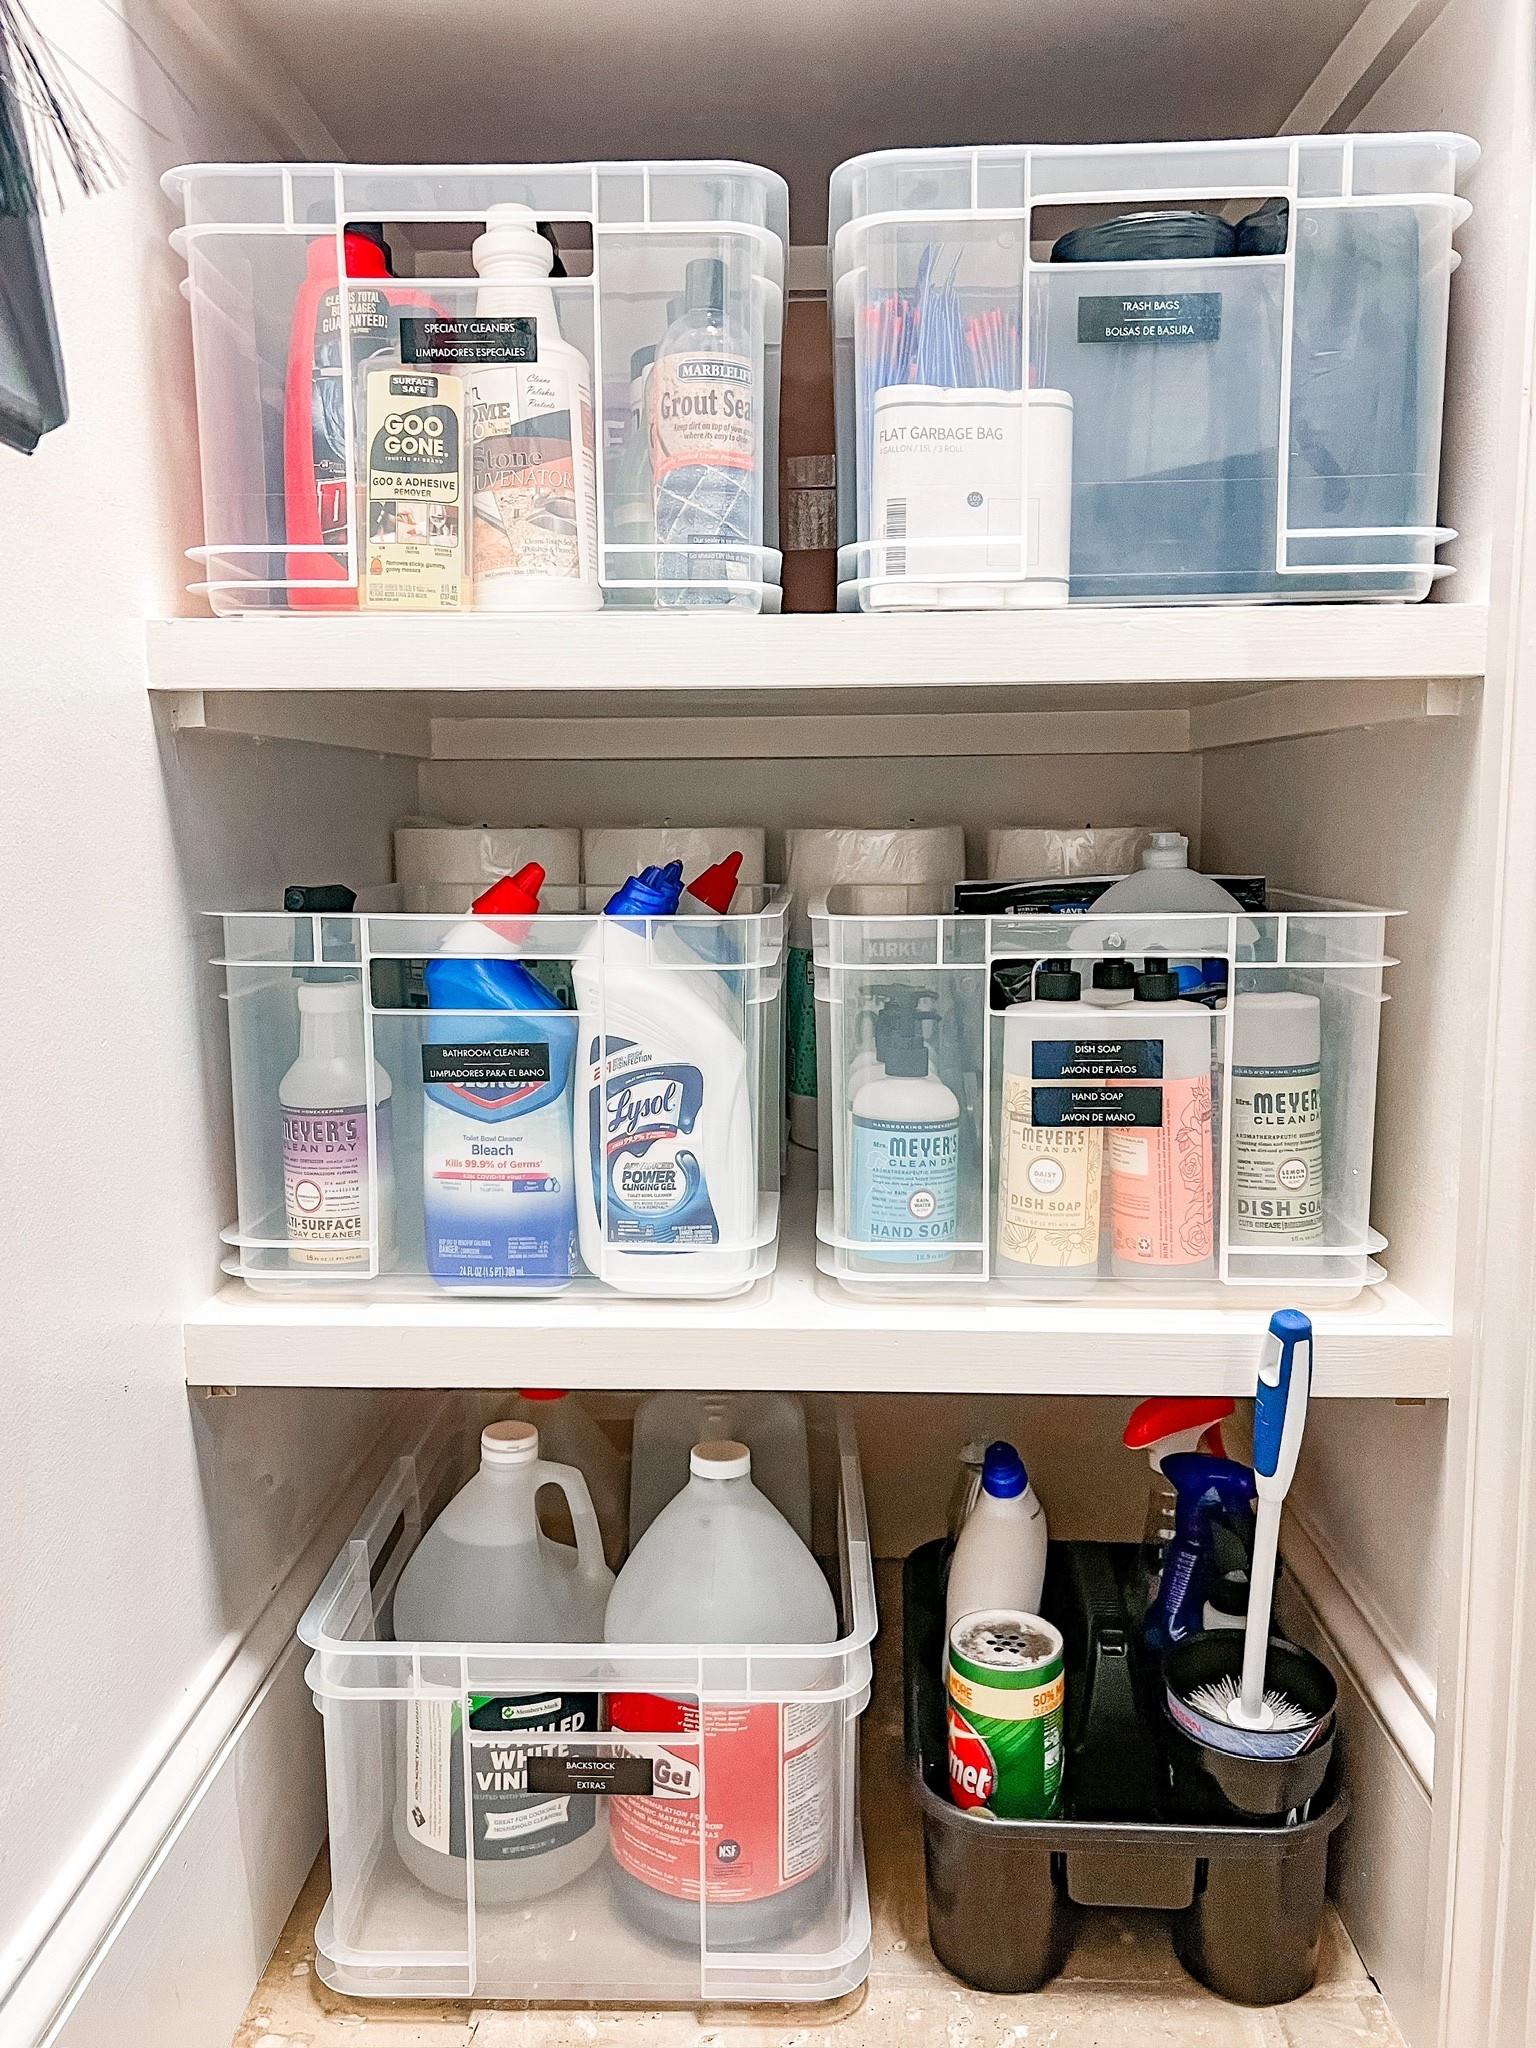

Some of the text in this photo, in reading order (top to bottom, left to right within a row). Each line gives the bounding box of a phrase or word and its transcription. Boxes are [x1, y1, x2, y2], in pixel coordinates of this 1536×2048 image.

[358, 291, 380, 303] TOTAL
[1122, 301, 1180, 310] TRASH BAGS
[322, 314, 388, 333] GUAANTEED!
[424, 323, 515, 333] SPECIALTY CLEANERS
[1105, 325, 1194, 336] BOLSAS DE BASURA
[416, 347, 525, 357] LIMPIADORES ESPECIALES
[392, 377, 434, 387] SURFACE
[402, 386, 427, 394] SAFE
[661, 389, 718, 419] Grout
[384, 413, 444, 437] GOO
[879, 426, 1003, 443] FLAT GARBAGE BAG
[384, 436, 444, 457] GONE
[372, 477, 455, 490] GOO & ADHESIVE
[393, 488, 432, 497] REMOVER
[442, 1048, 530, 1057] BATHROOM CLEANER
[1074, 1045, 1122, 1054] DISH SOAP
[430, 1068, 545, 1078] LIMPIADORES PARA EL BANO
[1060, 1065, 1137, 1075] JAVON DE PLATOS
[1071, 1092, 1123, 1101] HAND SOAP
[607, 1082, 677, 1133] Lysol
[1060, 1113, 1136, 1122] JAVON DE MANO
[1253, 1114, 1306, 1125] CLEAN
[462, 1134, 479, 1142] Toilet
[1022, 1127, 1085, 1146] MEYER'S
[326, 1142, 357, 1153] DAY
[471, 1144, 514, 1156] Bleach
[889, 1133, 957, 1158] MEYER'S
[1021, 1143, 1059, 1153] CLEAN
[445, 1159, 507, 1169] Kills 99.9% of
[888, 1159, 937, 1168] CLEAN
[621, 1170, 676, 1184] POWER
[1034, 1170, 1057, 1178] DAISY
[622, 1183, 677, 1191] CLINGING GEL
[1011, 1194, 1081, 1212] DISH SOAP
[1238, 1199, 1321, 1217] DISH SOA
[871, 1219, 955, 1238] HAND SOAP
[1238, 1219, 1254, 1228] CUTS
[311, 1230, 361, 1239] CLEANER
[459, 1266, 467, 1277] 24
[467, 1267, 474, 1277] FL
[475, 1267, 483, 1278] OZ
[1033, 1690, 1054, 1707] 50%
[566, 1761, 615, 1770] BACKSTOCK
[655, 1758, 691, 1788] Gel
[576, 1781, 606, 1790] EXTRAS
[528, 1808, 557, 1820] COOKING
[658, 1813, 697, 1829] MATERIAL
[493, 1821, 533, 1833] HOUSEHOLD
[718, 1845, 737, 1858] NSF
